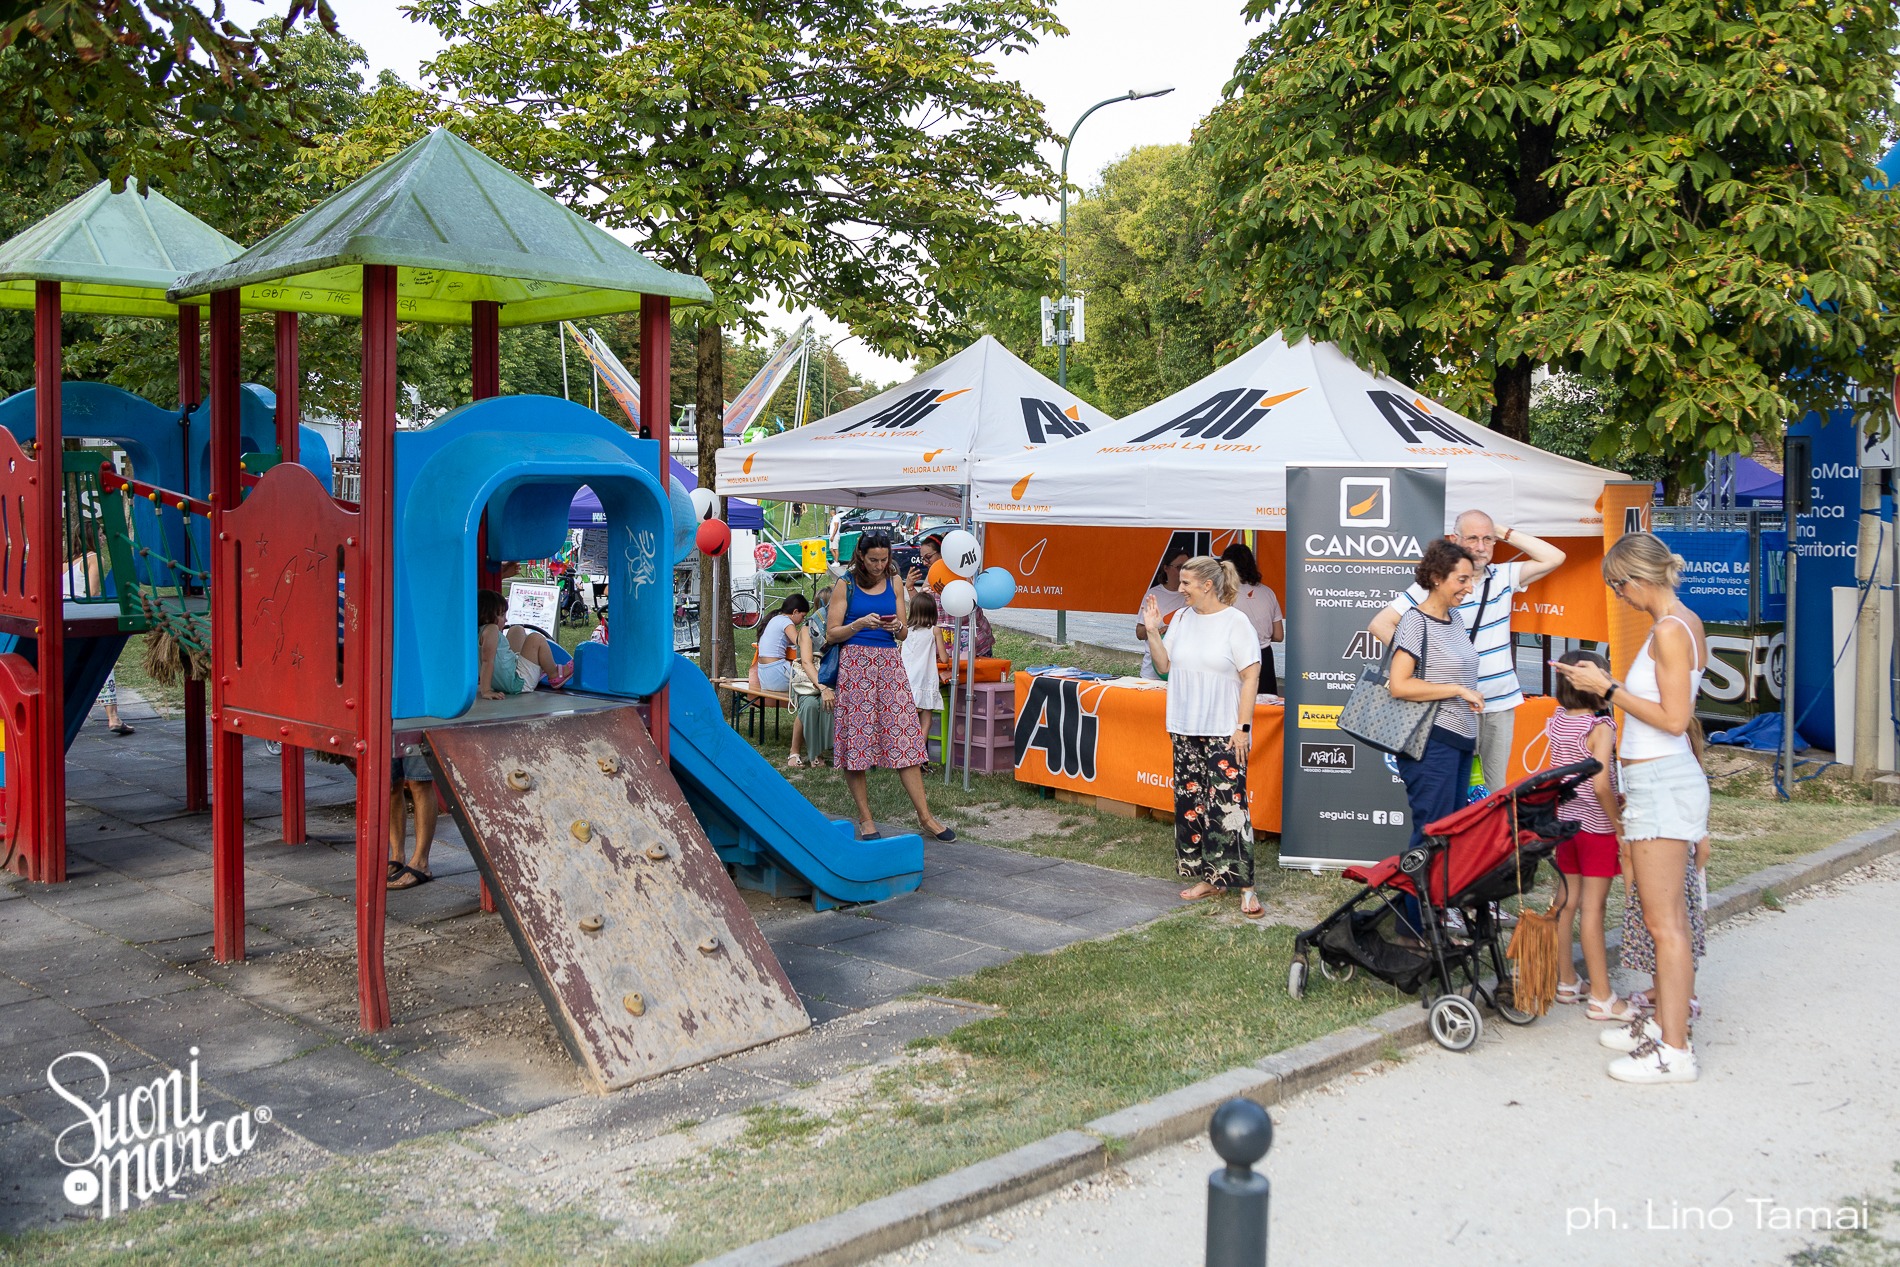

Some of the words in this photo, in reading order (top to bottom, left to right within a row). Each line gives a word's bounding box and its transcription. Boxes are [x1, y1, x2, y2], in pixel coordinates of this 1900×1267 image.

[251, 288, 290, 299] LGBT
[300, 290, 313, 301] IS
[327, 291, 350, 305] THE
[397, 299, 417, 312] ER
[890, 430, 924, 438] VITA!
[1096, 441, 1177, 454] MIGLIORA
[1181, 441, 1206, 451] LA
[1214, 443, 1262, 453] VITA!
[902, 466, 931, 474] MIGLIORA
[988, 503, 1021, 511] MIGLIORA
[1022, 504, 1032, 512] LA
[1305, 534, 1424, 558] CANOVA
[1797, 542, 1858, 558] erritorio
[1305, 564, 1341, 573] PARCO
[1345, 565, 1417, 575] COMMERCIAL
[1707, 575, 1715, 584] di
[1716, 576, 1742, 585] treviso
[1031, 586, 1041, 594] LA
[1043, 586, 1063, 595] VITA!
[1307, 588, 1323, 597] Via
[1325, 588, 1368, 599] Noalese,
[1369, 589, 1381, 598] 72
[1690, 586, 1725, 595] GRUPPO
[1727, 587, 1748, 596] BCC
[1315, 599, 1352, 608] FRONTE
[1513, 602, 1530, 613] LA
[1534, 602, 1565, 616] VITA!
[1309, 671, 1357, 682] euronics
[1302, 711, 1340, 720] ARCAPLA
[1319, 810, 1355, 821] seguici
[1357, 812, 1369, 821] su
